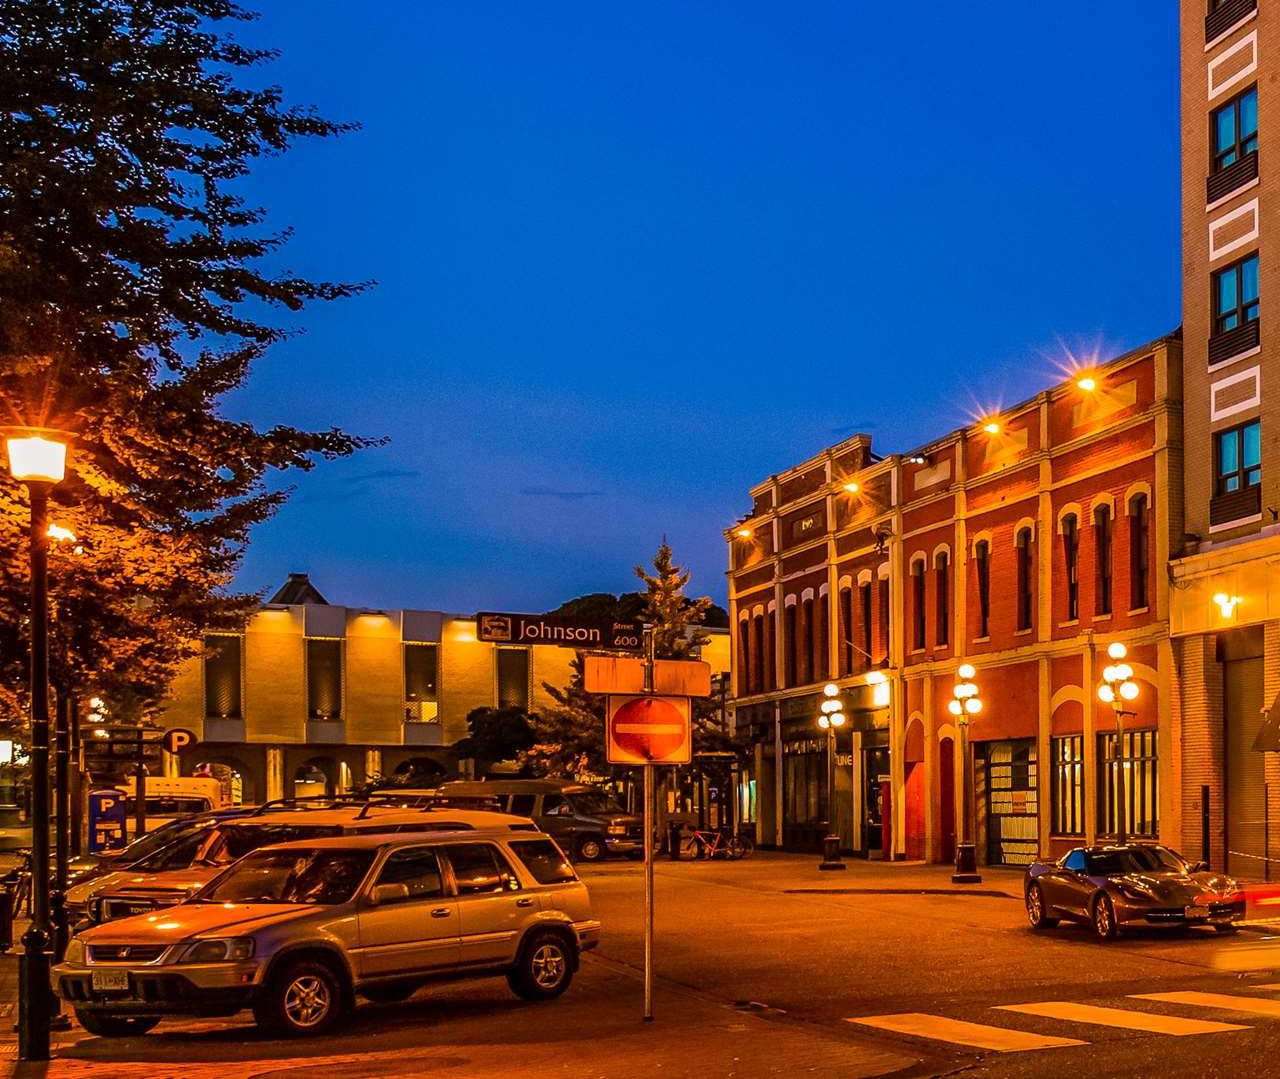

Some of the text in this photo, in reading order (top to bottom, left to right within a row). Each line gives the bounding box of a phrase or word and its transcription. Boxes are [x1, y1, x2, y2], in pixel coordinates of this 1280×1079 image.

[518, 620, 600, 641] Johnson
[614, 635, 638, 646] 600
[171, 731, 190, 752] P
[101, 798, 115, 812] P
